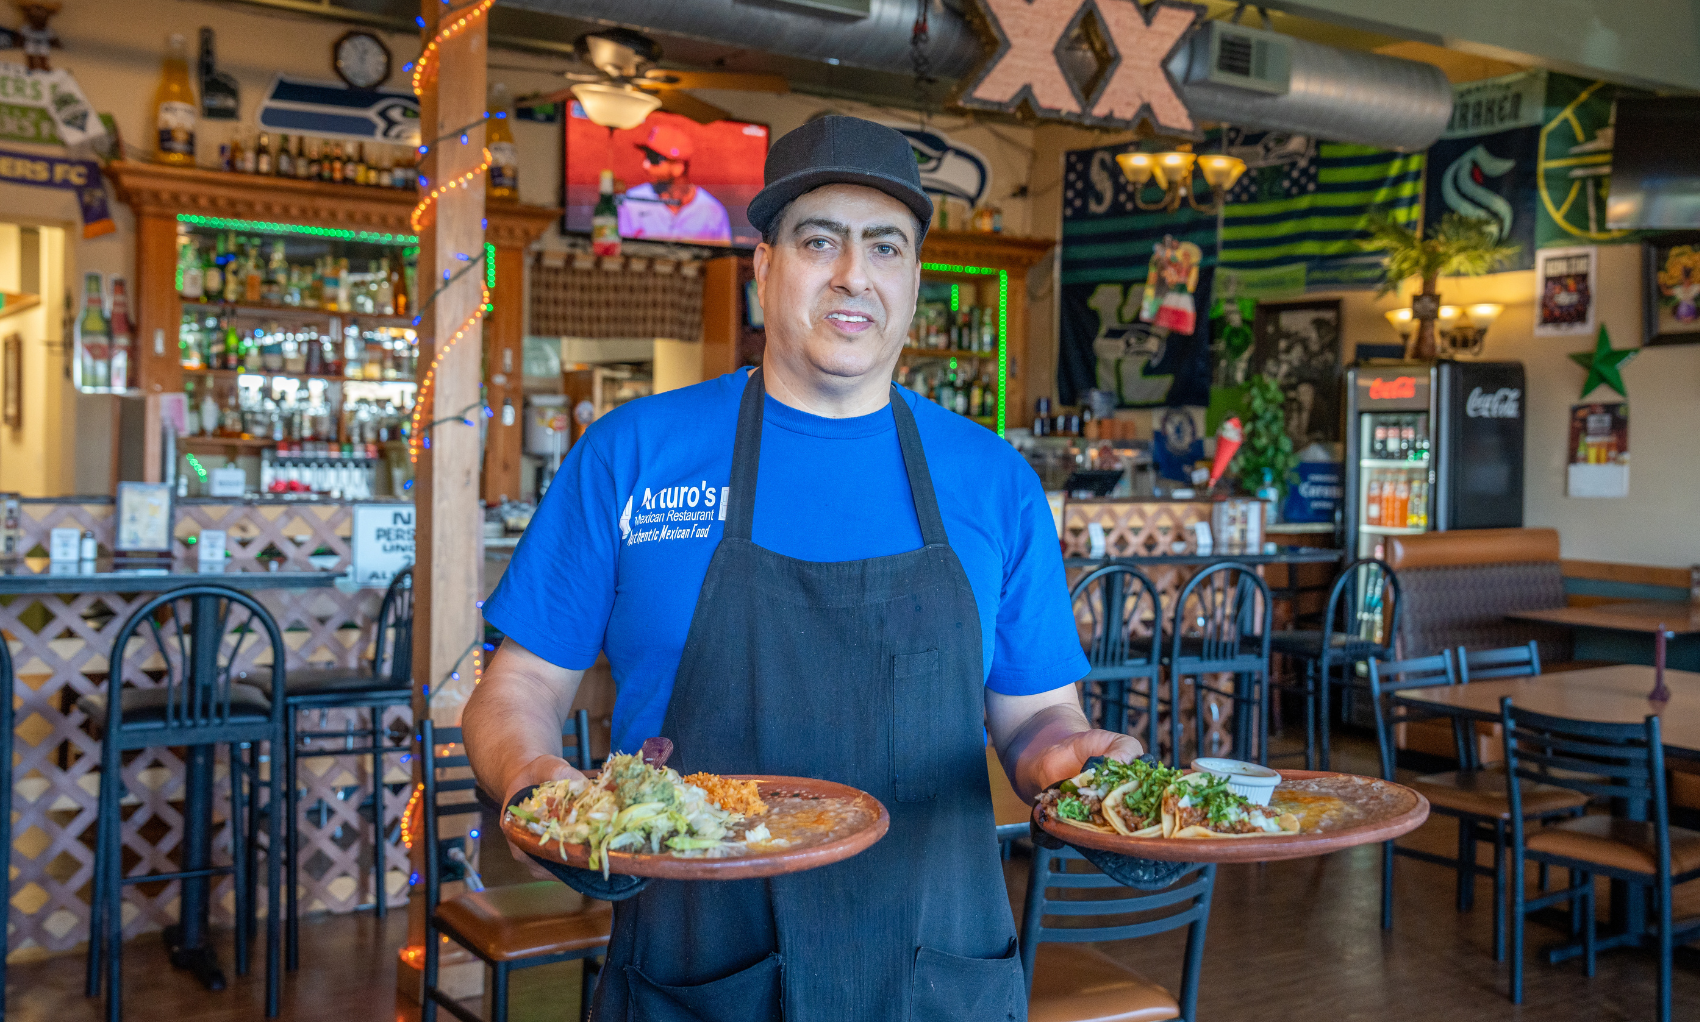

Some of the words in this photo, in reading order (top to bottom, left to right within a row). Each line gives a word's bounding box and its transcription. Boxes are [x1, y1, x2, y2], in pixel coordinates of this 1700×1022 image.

[53, 164, 89, 186] FC
[641, 480, 717, 510] Arturo's
[635, 511, 665, 527] Mexican
[666, 509, 714, 522] Restaurant
[658, 524, 690, 543] Mexican
[690, 523, 711, 539] Food
